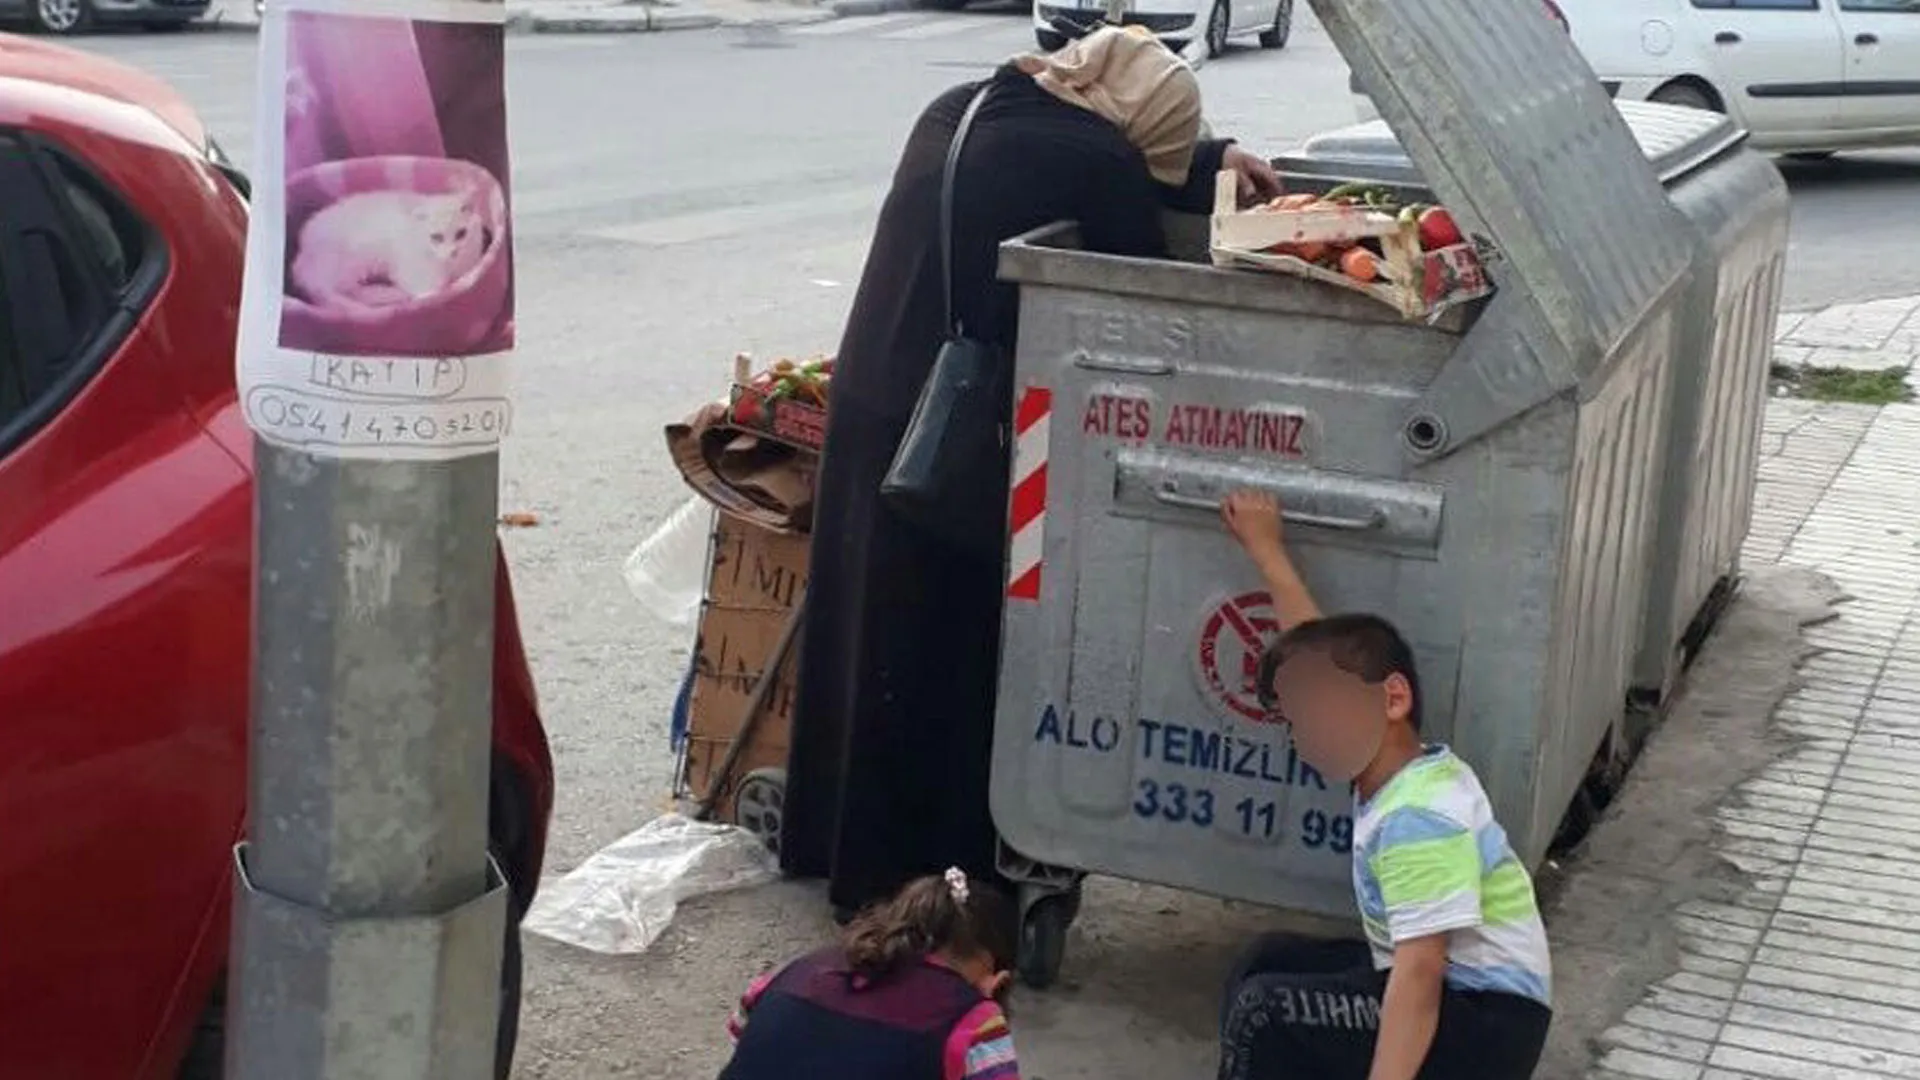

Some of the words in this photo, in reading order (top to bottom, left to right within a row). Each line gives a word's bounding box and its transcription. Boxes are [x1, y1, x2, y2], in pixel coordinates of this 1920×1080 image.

[325, 358, 452, 388] KAYIP
[1034, 703, 1120, 752] ALO
[1134, 778, 1215, 827] 333
[1235, 797, 1276, 838] 11
[1301, 808, 1354, 854] 99
[1276, 986, 1380, 1031] WHITE
